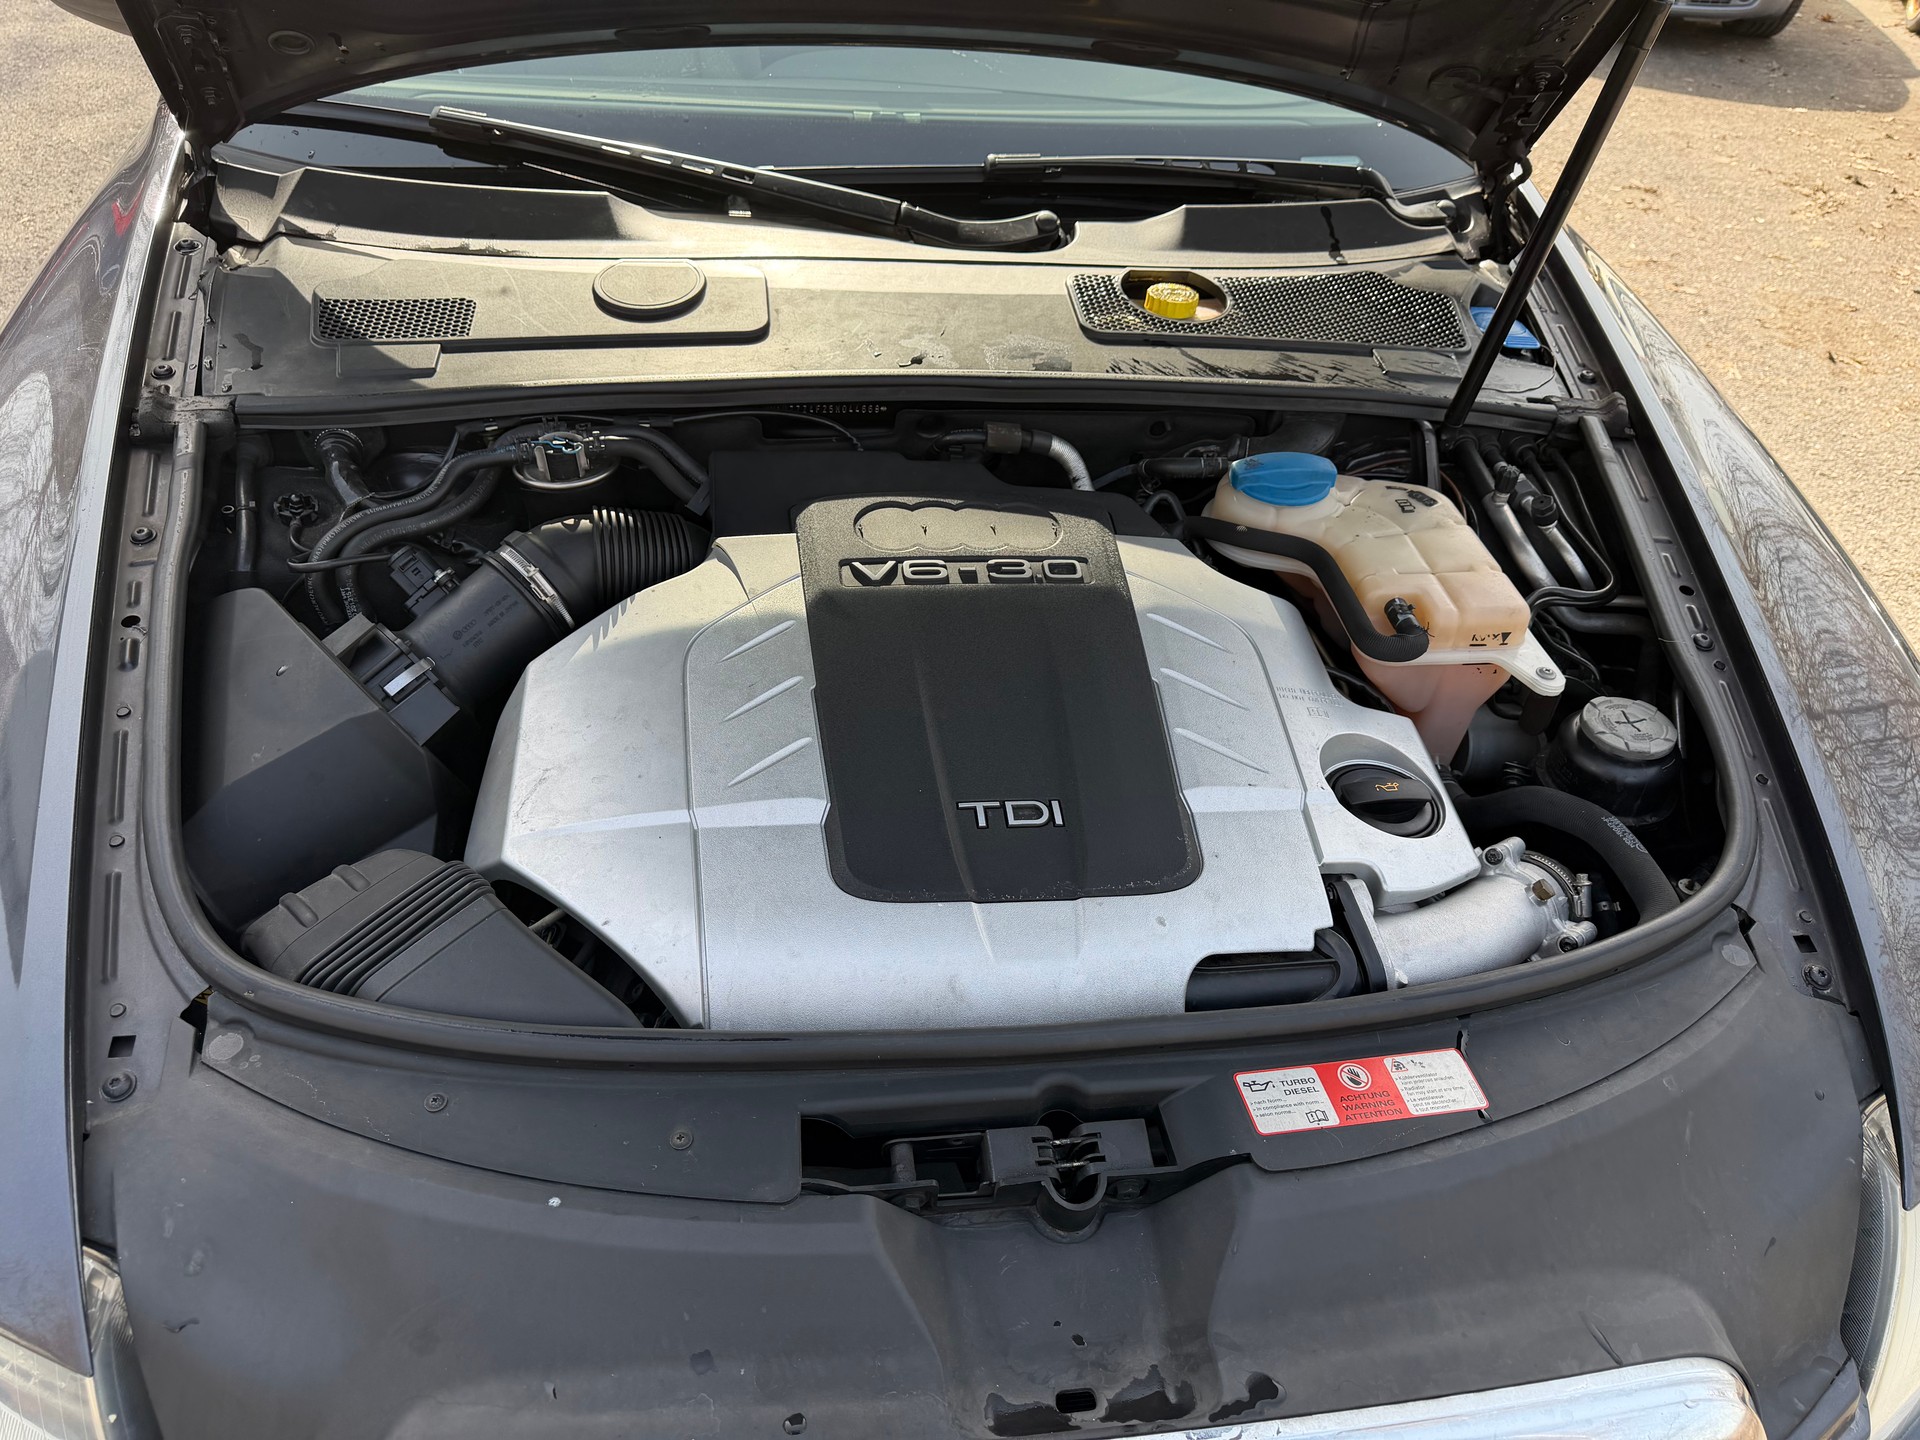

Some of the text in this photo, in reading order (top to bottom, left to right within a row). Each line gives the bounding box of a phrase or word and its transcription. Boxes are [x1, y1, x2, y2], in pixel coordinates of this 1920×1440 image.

[957, 800, 1064, 828] TDI
[1279, 1077, 1316, 1087] TURBO
[1283, 1086, 1320, 1096] DIESEL
[1340, 1090, 1391, 1102] ACHTUNG
[1342, 1099, 1395, 1111] WARNING
[1346, 1108, 1402, 1121] ATTENTION
